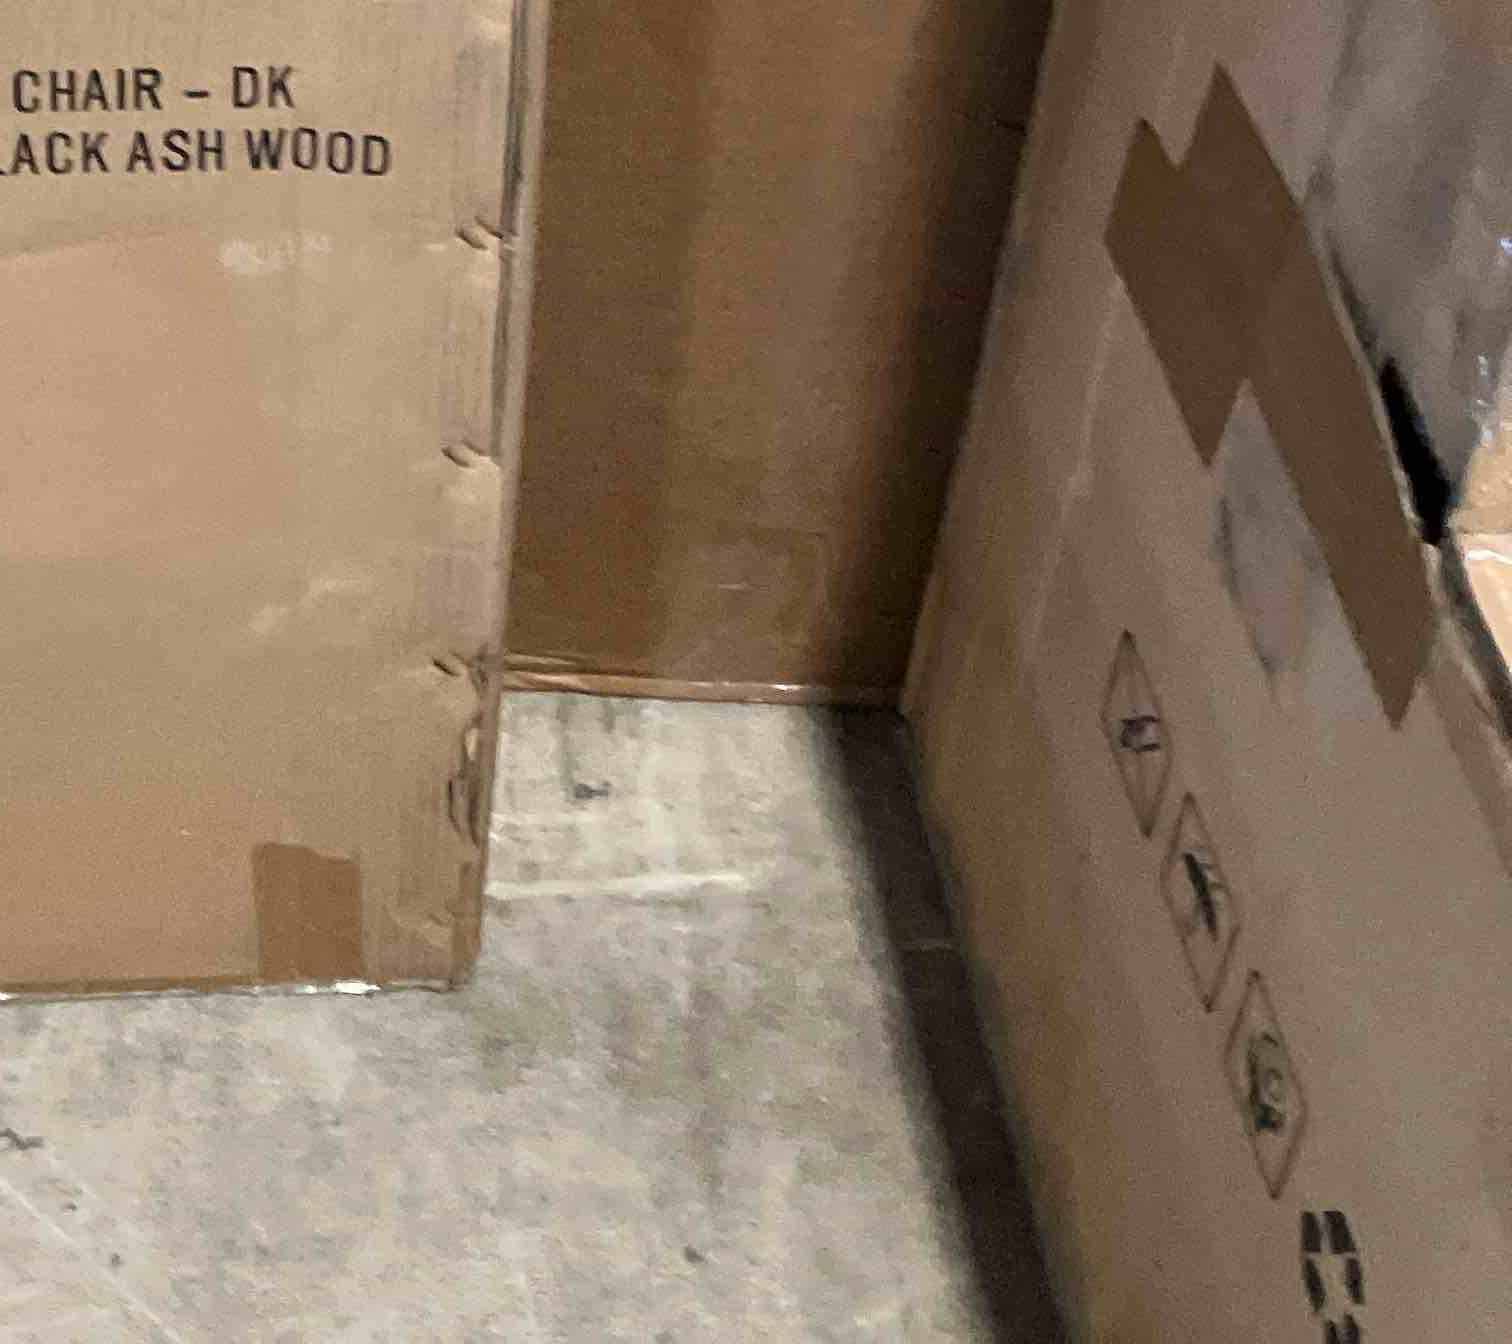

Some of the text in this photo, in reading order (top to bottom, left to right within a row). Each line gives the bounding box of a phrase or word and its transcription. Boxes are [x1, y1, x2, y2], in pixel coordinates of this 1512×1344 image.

[12, 66, 163, 113] CHAIR
[232, 65, 296, 109] DK
[126, 128, 226, 173] ASH
[246, 126, 393, 177] WOOD
